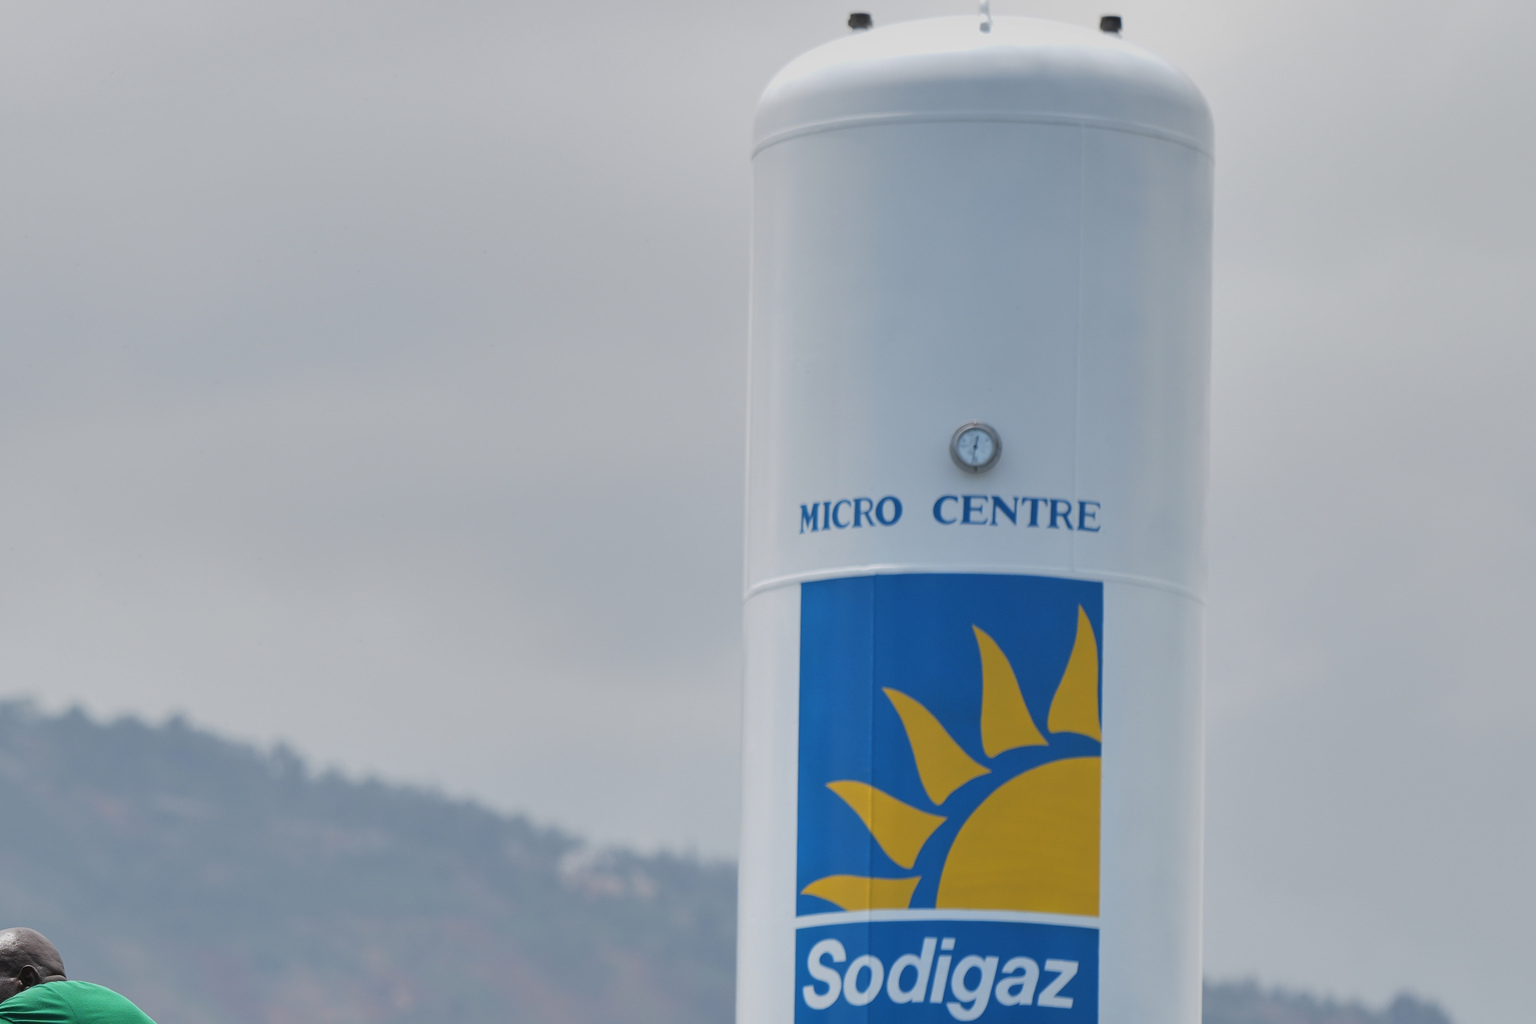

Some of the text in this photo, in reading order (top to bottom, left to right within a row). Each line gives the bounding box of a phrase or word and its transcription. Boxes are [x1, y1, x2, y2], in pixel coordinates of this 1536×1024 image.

[798, 494, 1102, 534] MICRO CENTRE
[801, 936, 1080, 1022] Sodigaz
